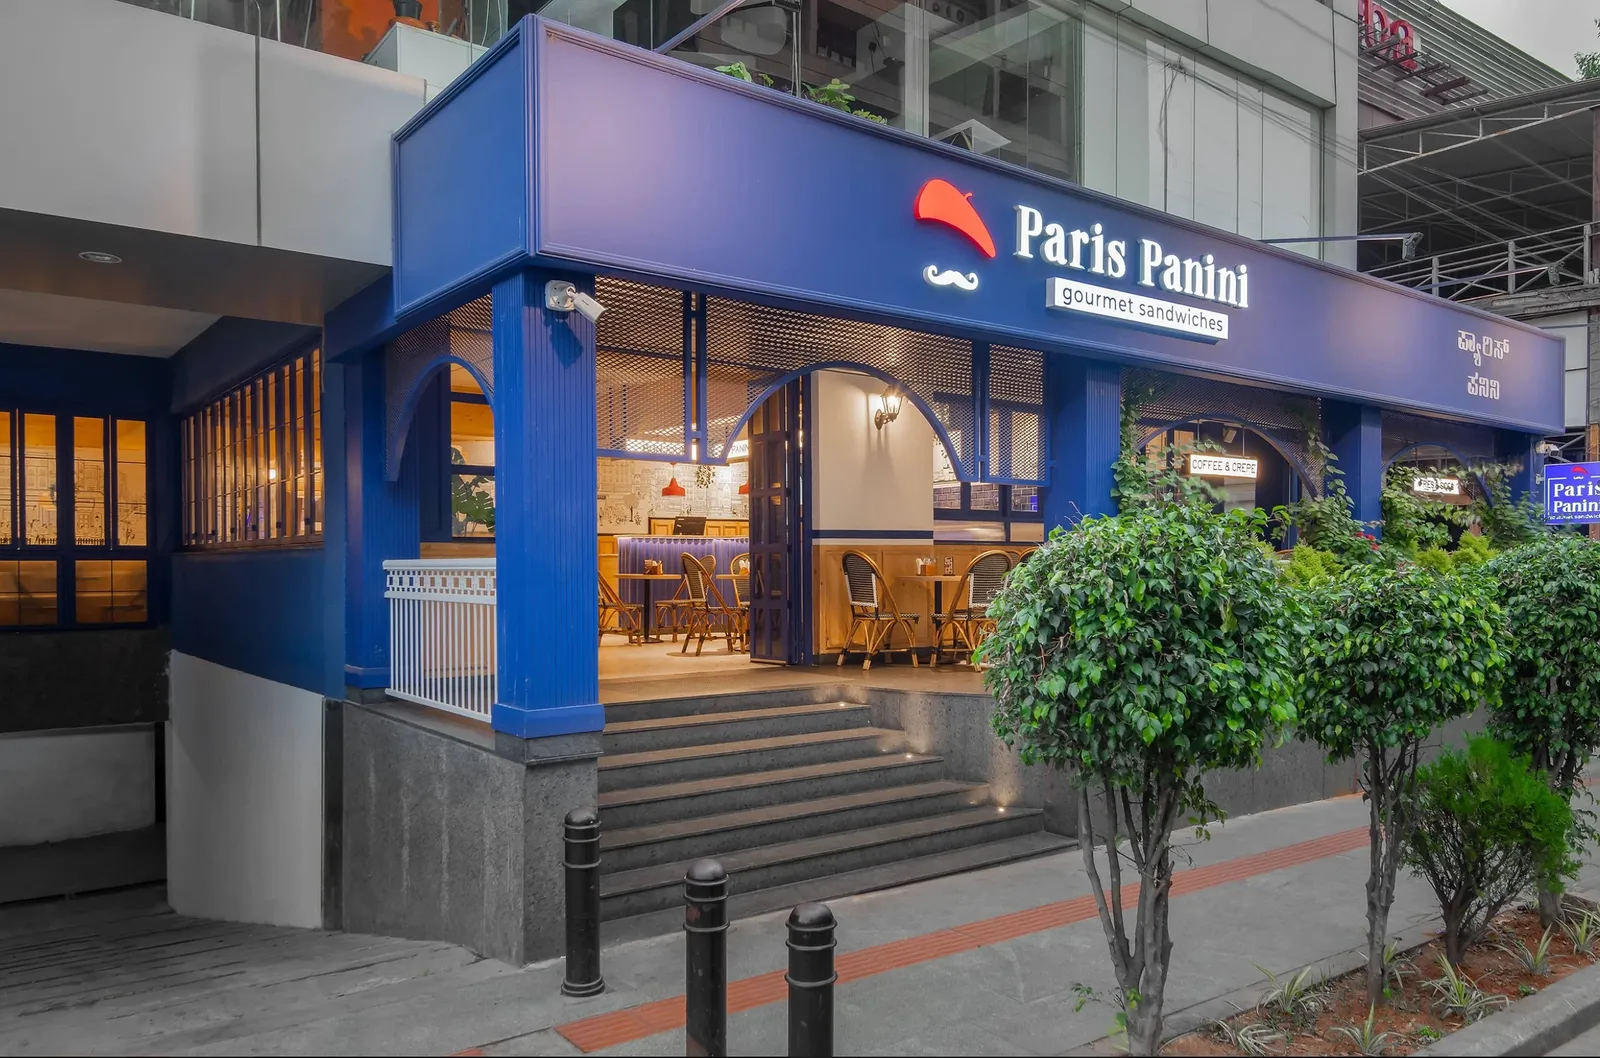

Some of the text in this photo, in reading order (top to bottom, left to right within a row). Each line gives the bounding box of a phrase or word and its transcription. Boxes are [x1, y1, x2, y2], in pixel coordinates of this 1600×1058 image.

[1013, 204, 1249, 309] Paris Panini
[1062, 287, 1224, 333] gourmet sandwiches
[1192, 459, 1256, 474] COFFEE & CREPE
[1553, 481, 1600, 498] Paris
